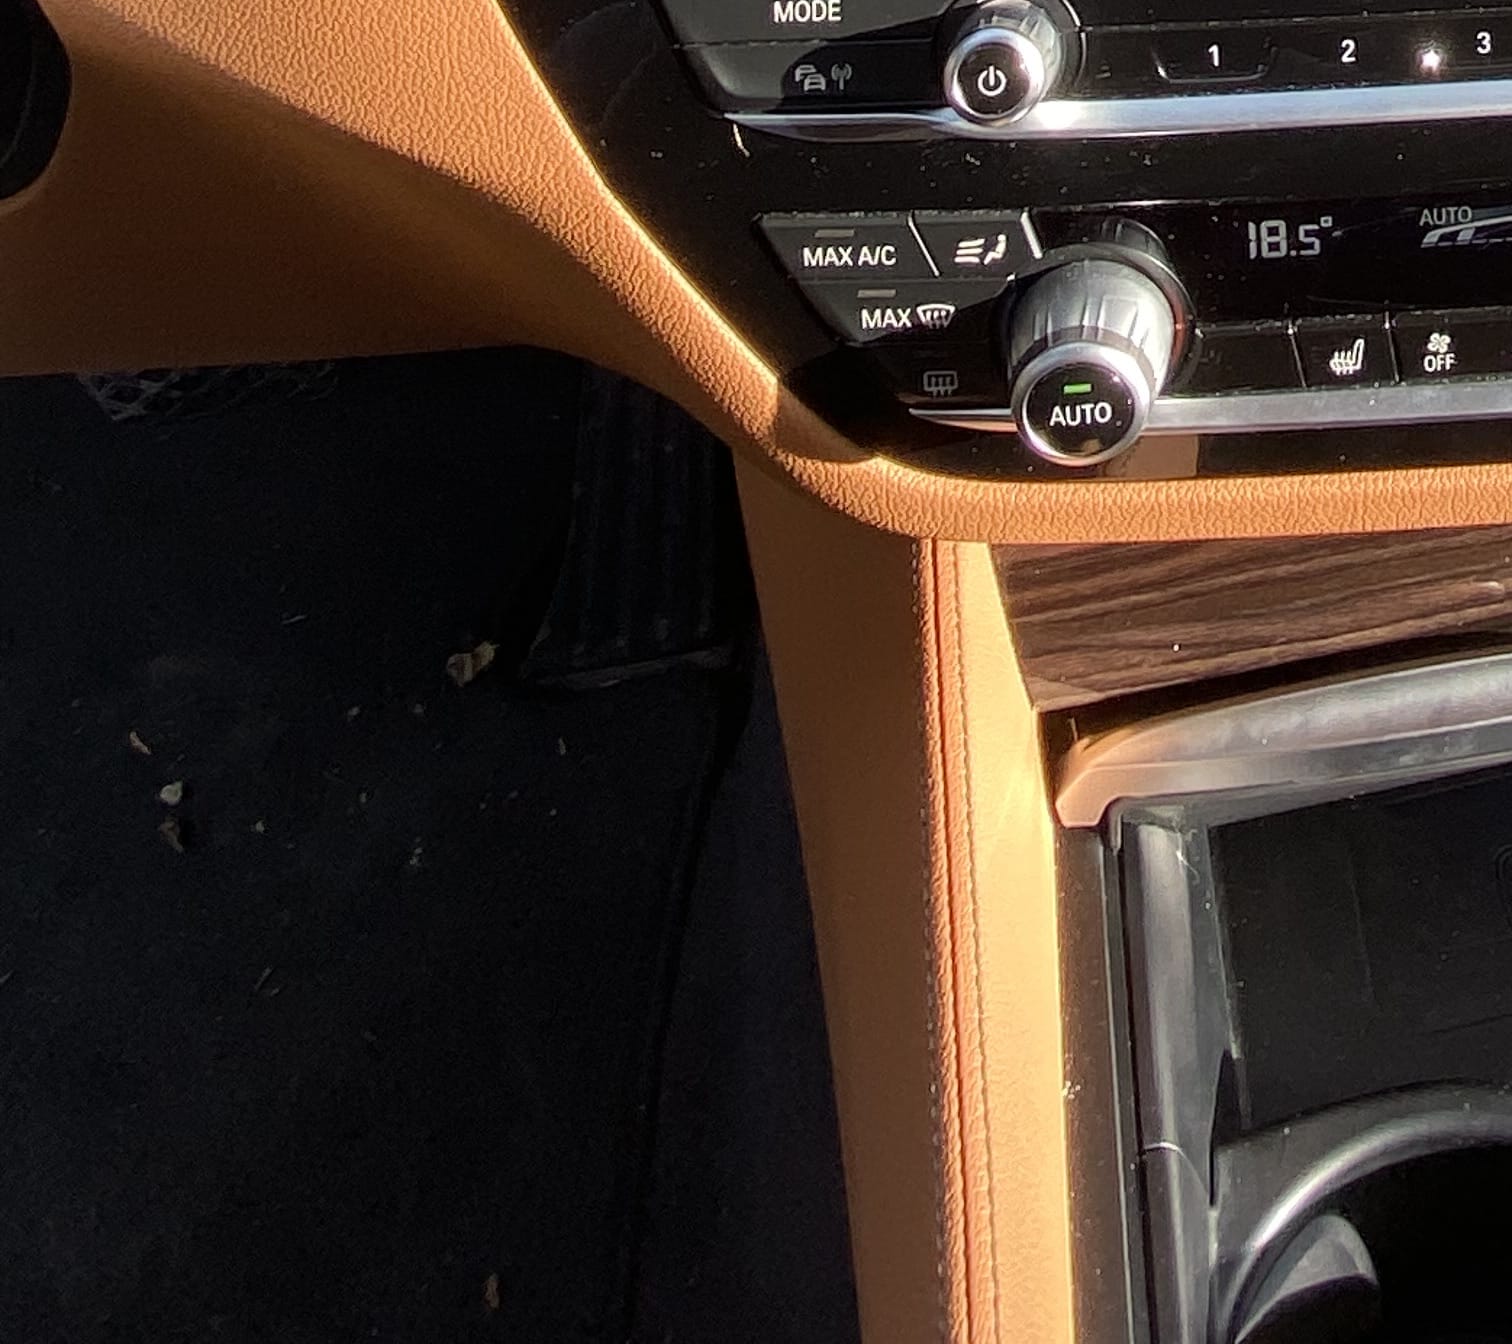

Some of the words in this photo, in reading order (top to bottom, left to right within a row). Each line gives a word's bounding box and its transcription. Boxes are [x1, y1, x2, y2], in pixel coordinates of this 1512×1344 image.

[773, 0, 842, 24] MODE
[1341, 40, 1357, 63] 2
[1476, 33, 1492, 54] 3
[1207, 44, 1221, 67] 1
[1419, 206, 1473, 227] AUTO
[803, 245, 852, 268] MAX
[857, 244, 897, 267] A/C
[861, 307, 911, 330] MAX
[1423, 353, 1455, 372] OFF
[1049, 402, 1113, 426] AUTO
